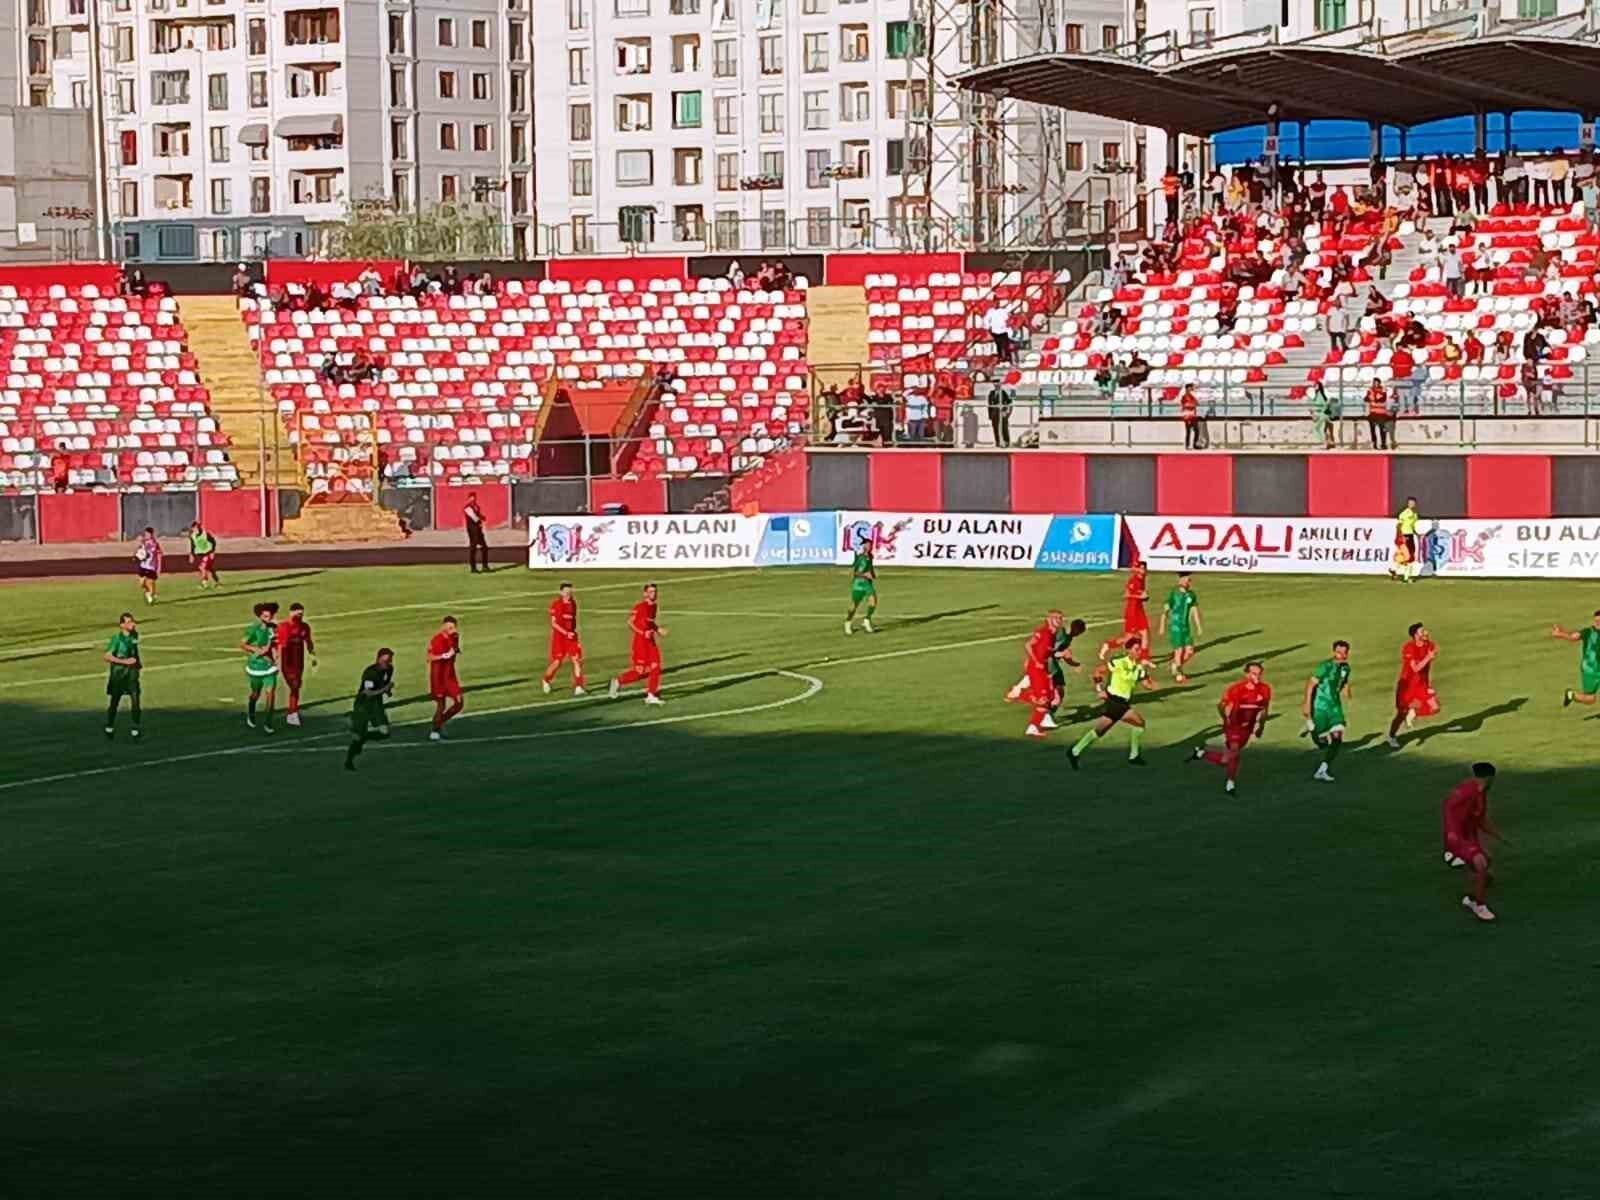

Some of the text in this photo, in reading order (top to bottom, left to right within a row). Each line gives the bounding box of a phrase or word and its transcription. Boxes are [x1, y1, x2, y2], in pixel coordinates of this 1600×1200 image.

[627, 519, 736, 535] BU ALANI
[923, 519, 1022, 535] BU ALANI
[1299, 527, 1348, 541] AKILLI
[1517, 525, 1551, 541] BU
[1150, 522, 1293, 552] ADALI
[618, 542, 667, 560] SİZE
[674, 543, 750, 559] AYIRDI
[914, 541, 957, 559] SİZE
[962, 544, 1033, 560] AYIRDI
[1508, 549, 1560, 568] SİZE
